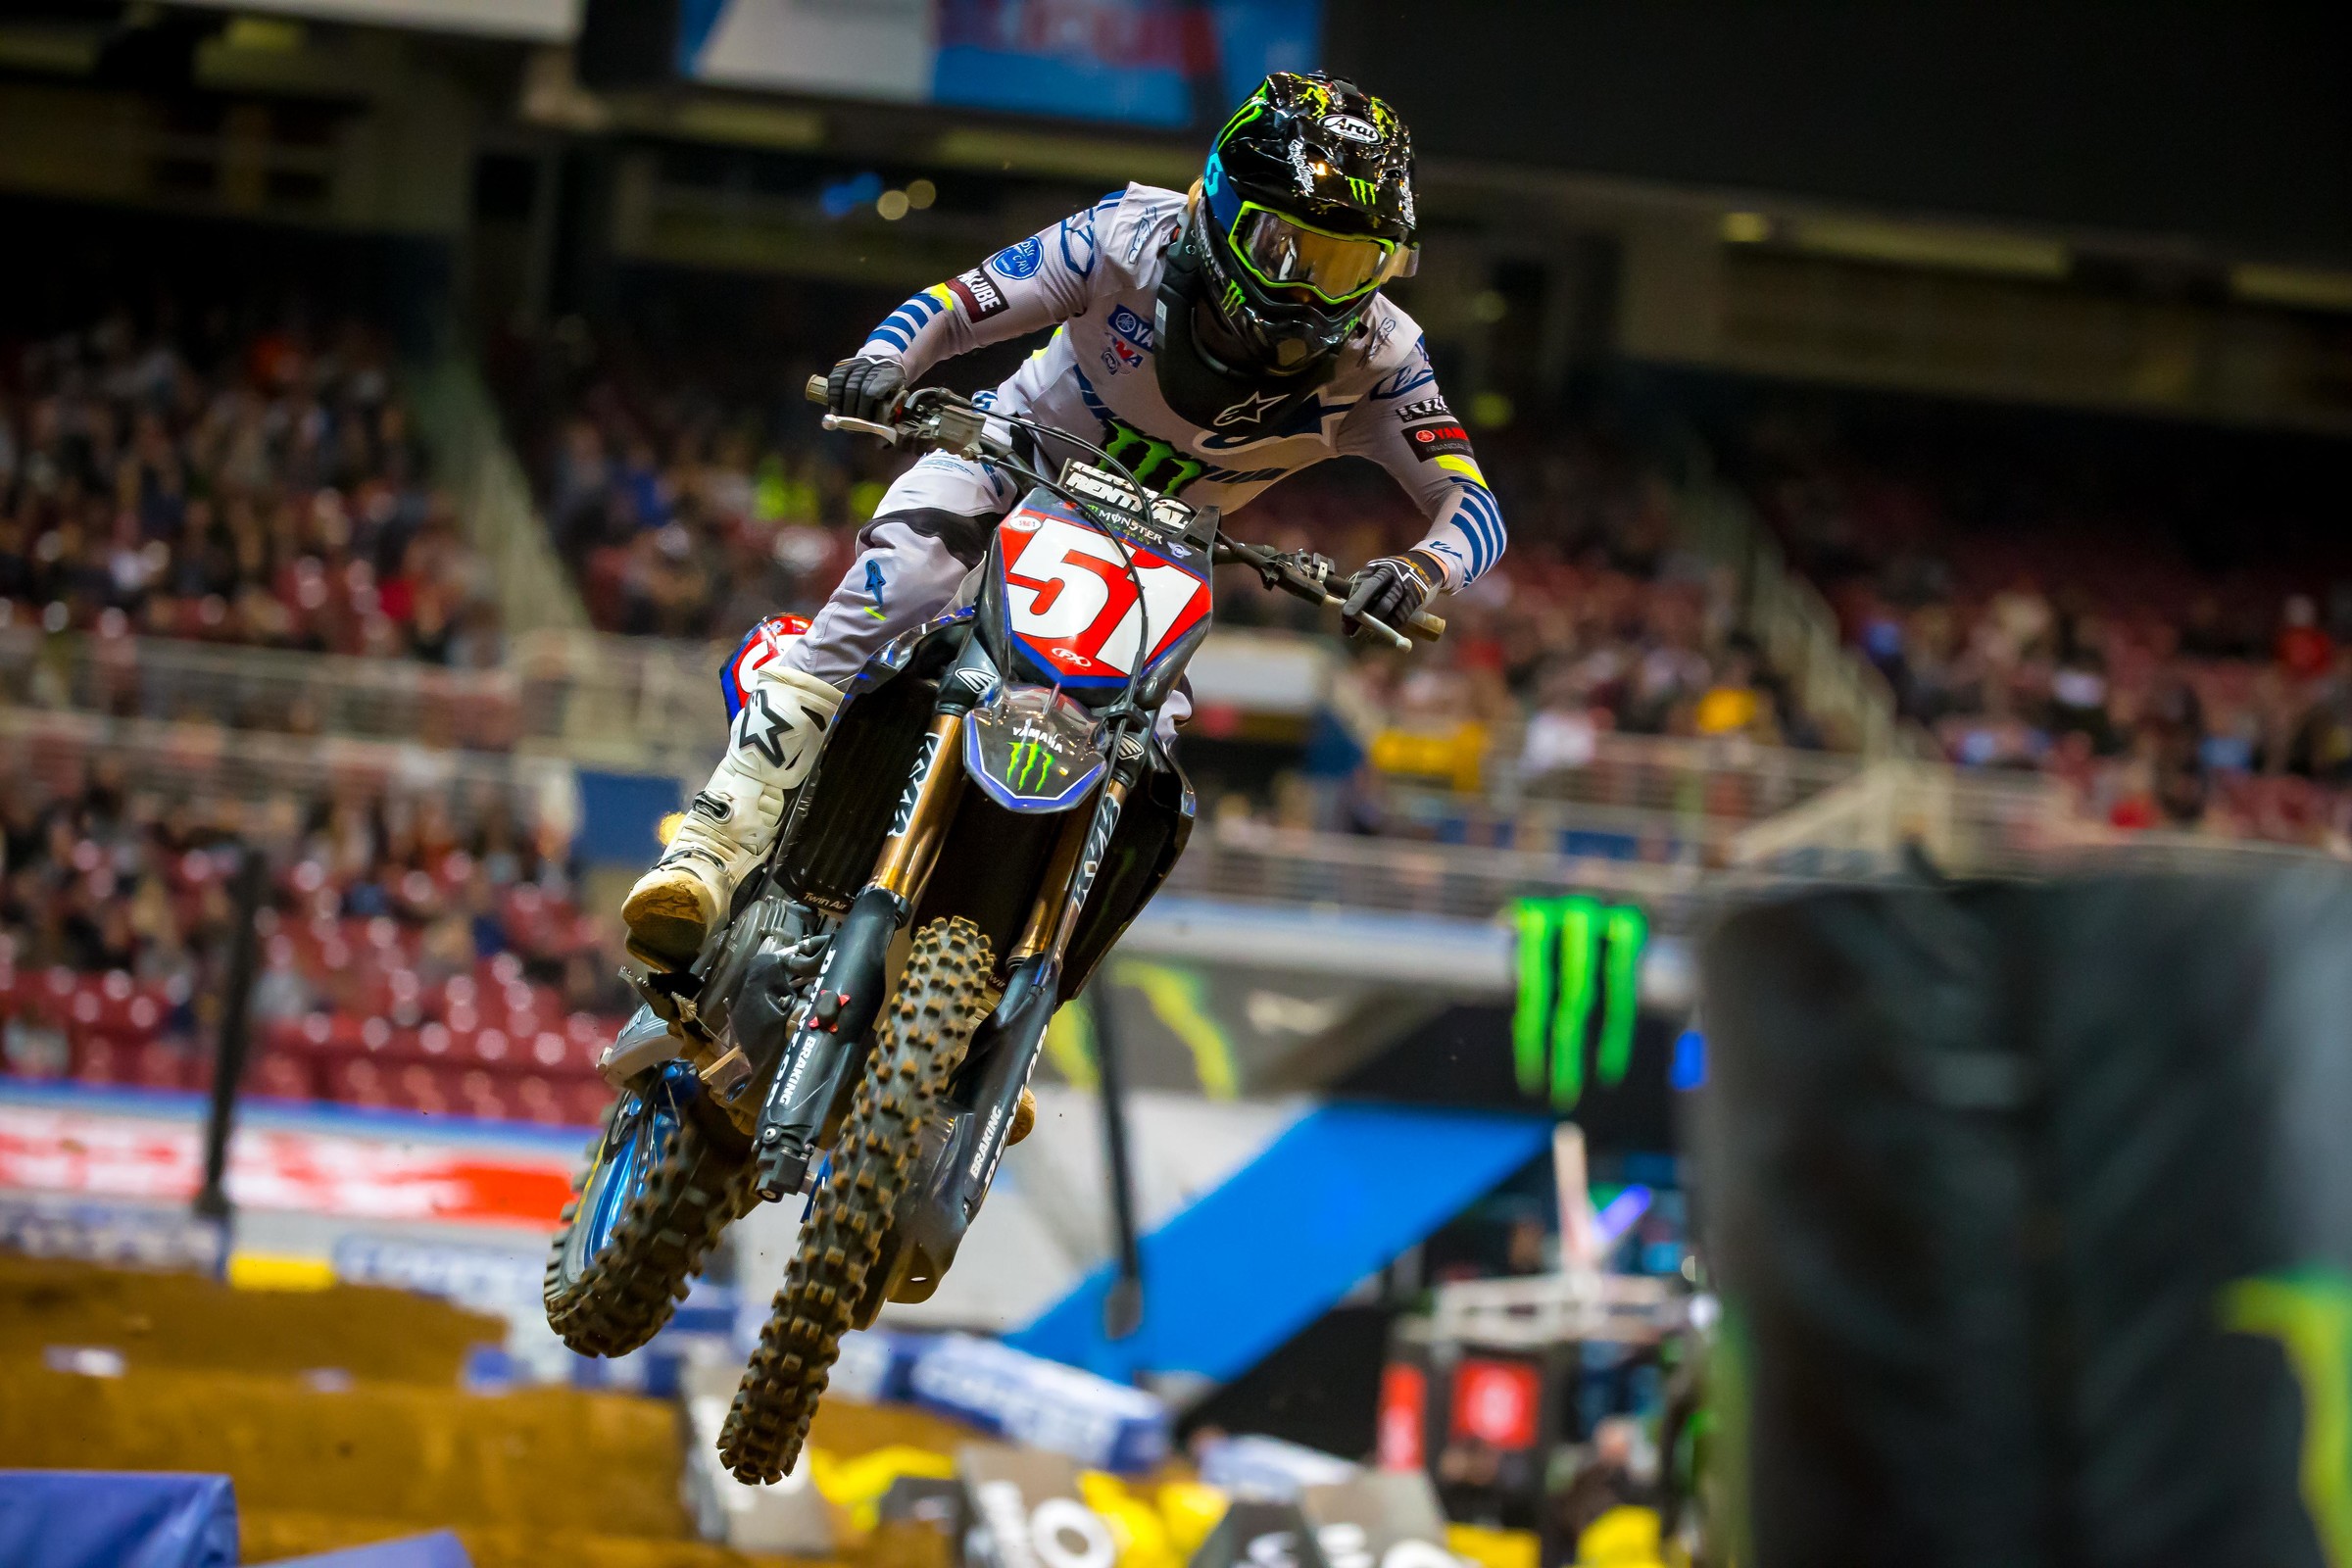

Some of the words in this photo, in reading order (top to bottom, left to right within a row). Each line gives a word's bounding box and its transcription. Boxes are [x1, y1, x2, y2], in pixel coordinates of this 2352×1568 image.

[1323, 118, 1375, 139] Arai
[1006, 517, 1202, 676] 51
[1012, 726, 1063, 754] YAMAHA
[804, 892, 830, 906] Twin
[829, 900, 848, 910] Air
[779, 1035, 817, 1106] BRAKING
[970, 1103, 1004, 1180] BRAKING
